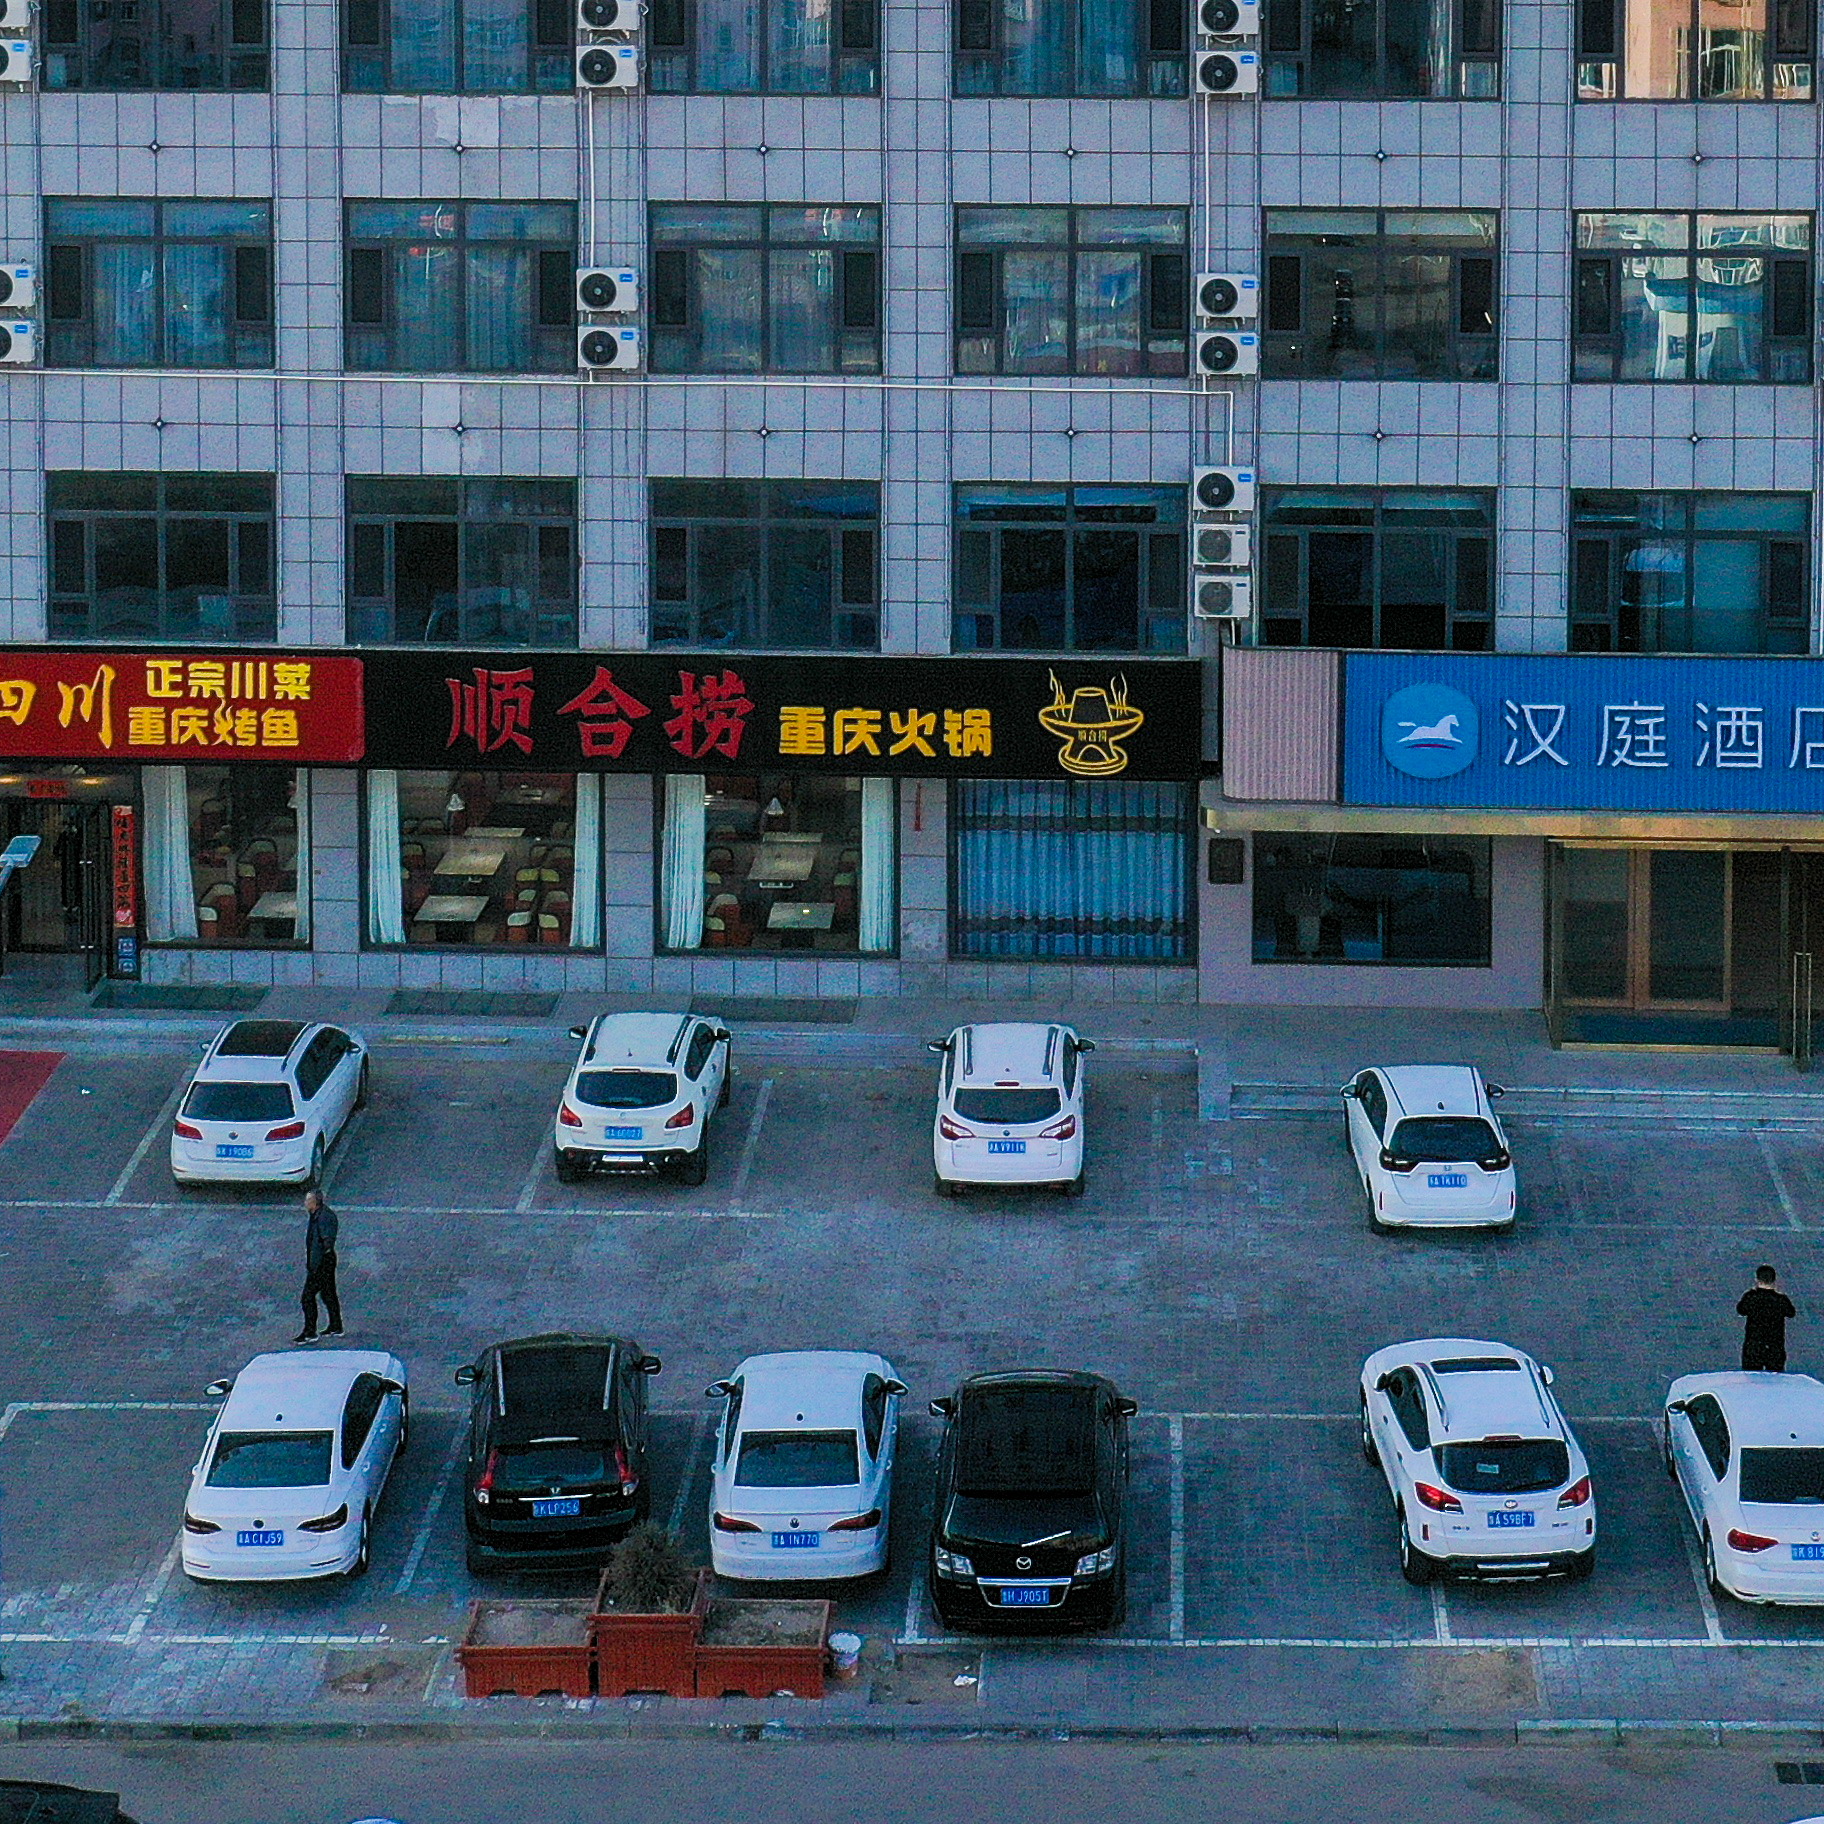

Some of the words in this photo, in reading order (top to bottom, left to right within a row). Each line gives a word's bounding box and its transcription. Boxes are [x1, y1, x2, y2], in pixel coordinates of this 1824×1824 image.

[145, 659, 311, 700] 正宗川菜
[128, 700, 300, 747] 重庆烤鱼
[444, 666, 756, 759] 顺合捞
[779, 705, 993, 757] 重庆火锅
